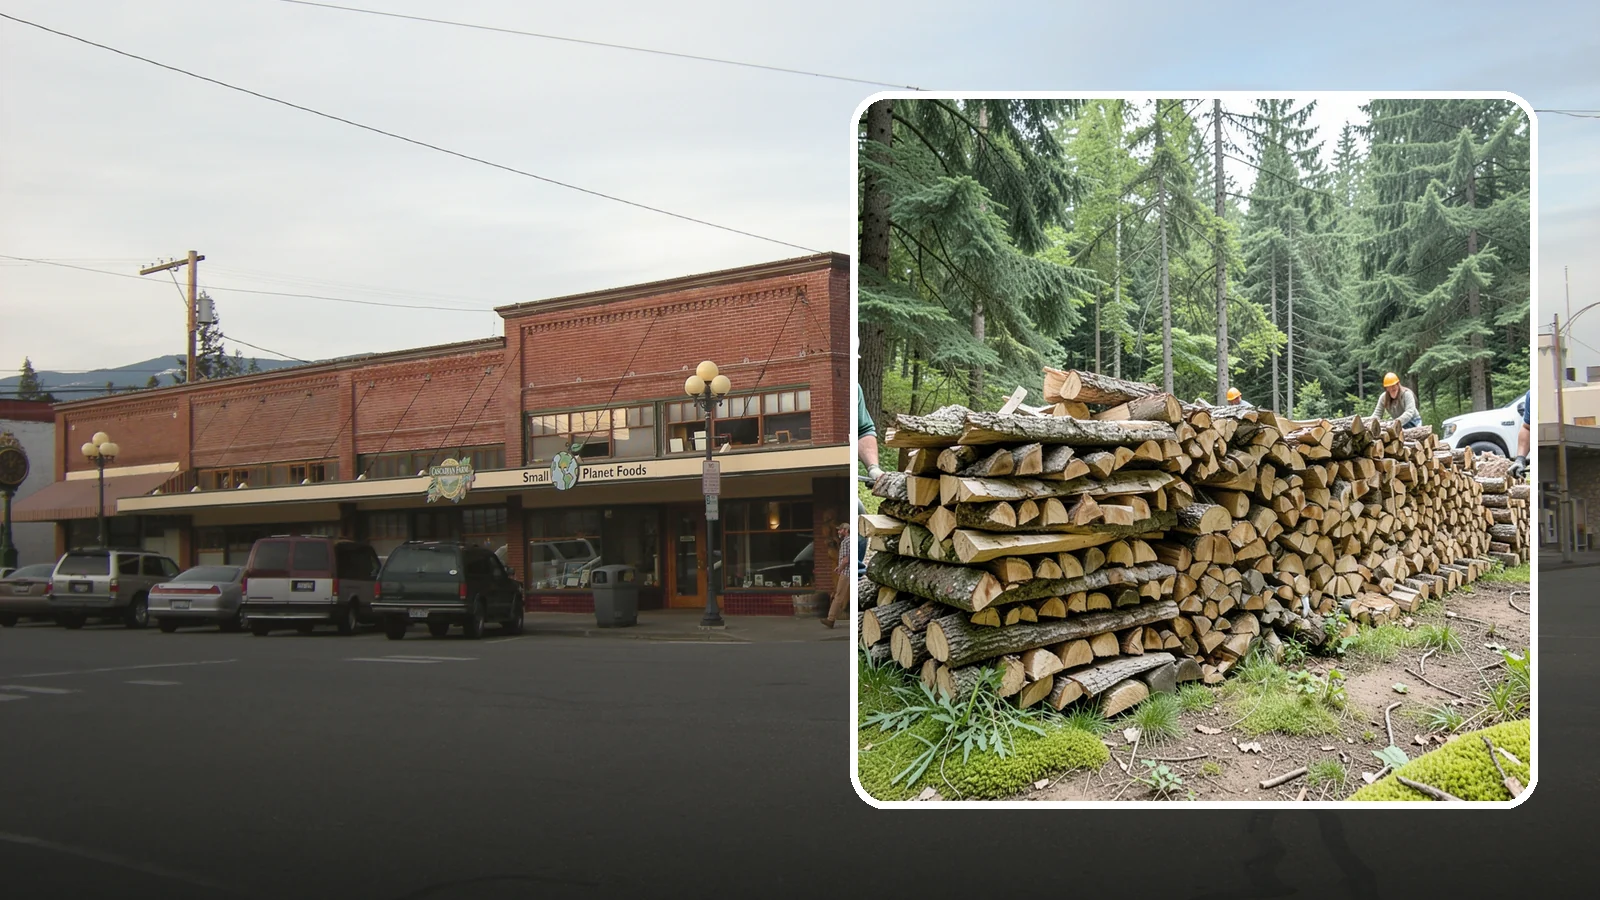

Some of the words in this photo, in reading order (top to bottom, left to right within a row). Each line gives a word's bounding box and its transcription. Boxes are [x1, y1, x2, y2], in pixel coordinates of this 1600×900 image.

[523, 471, 549, 483] Small
[583, 468, 614, 479] Planet
[617, 465, 647, 477] Foods
